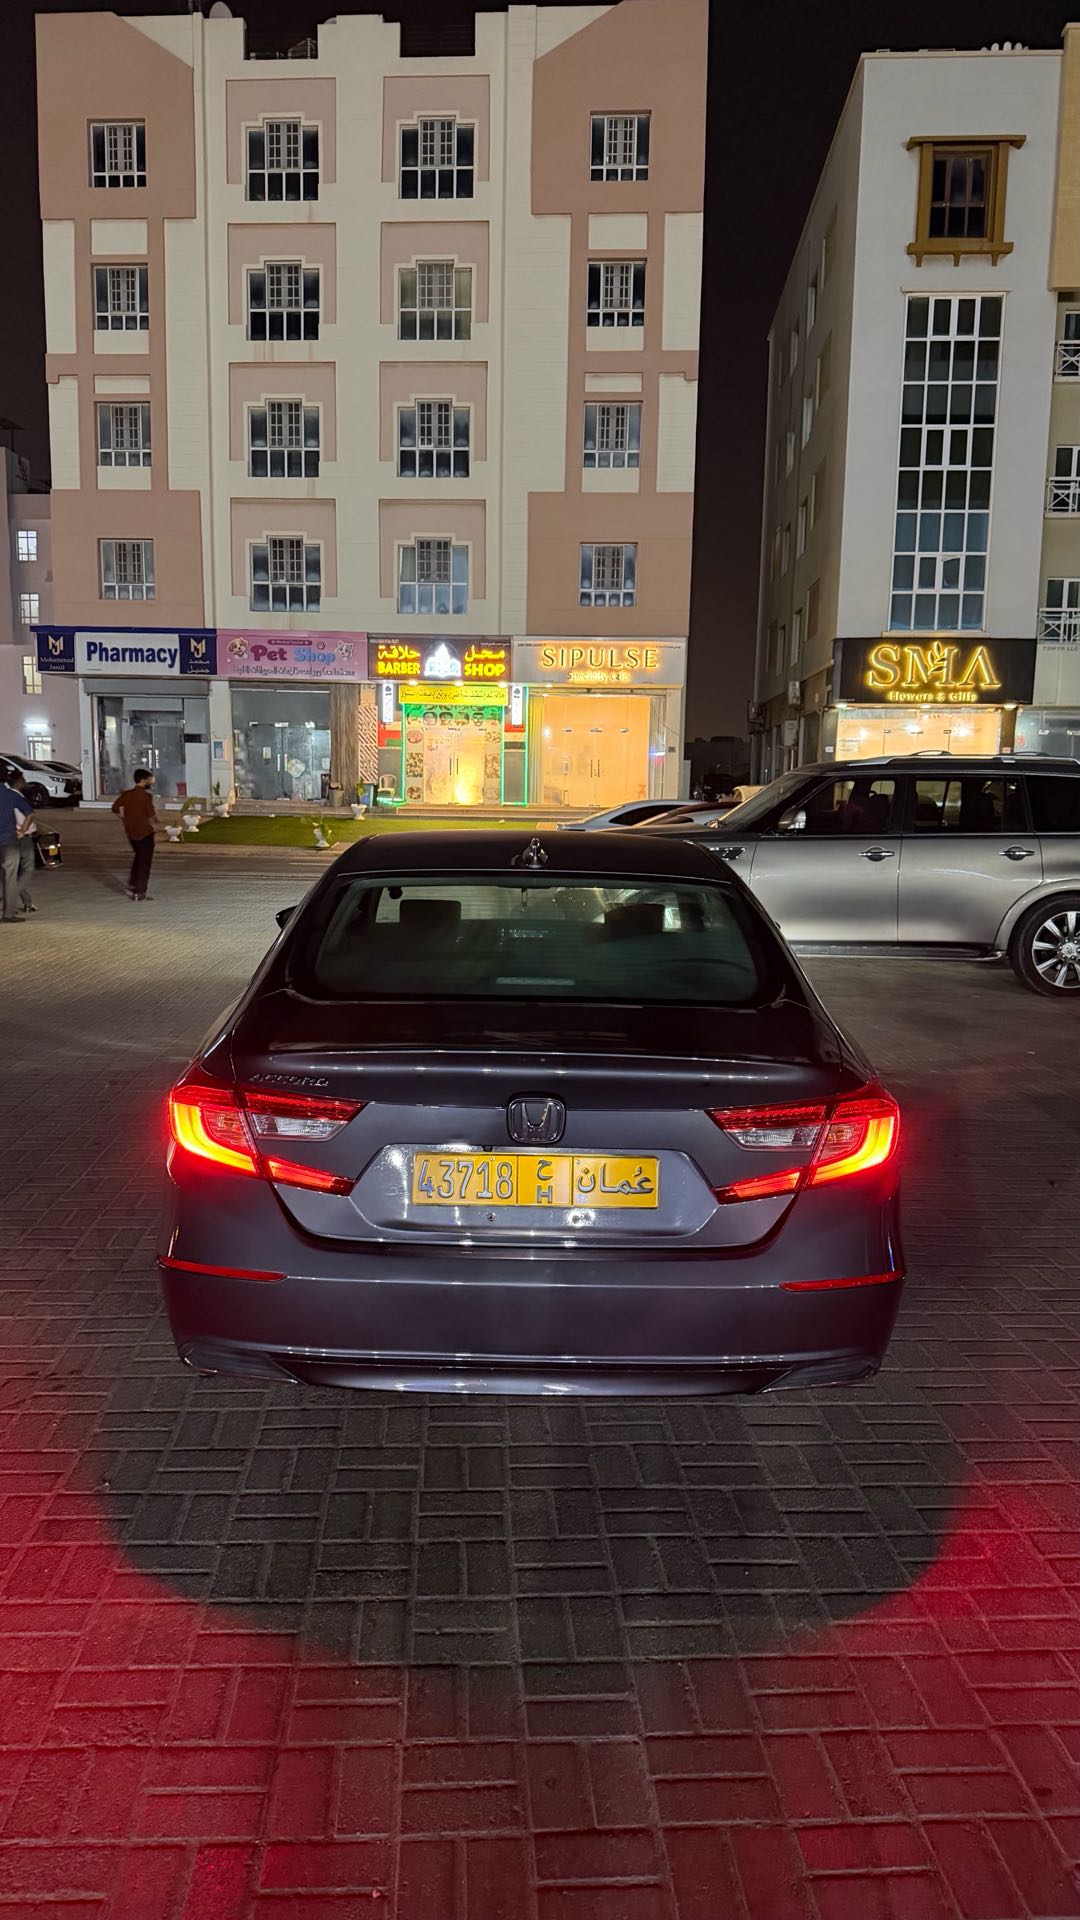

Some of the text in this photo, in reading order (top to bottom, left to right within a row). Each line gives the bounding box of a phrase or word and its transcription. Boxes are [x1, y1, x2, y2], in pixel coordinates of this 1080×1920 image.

[86, 641, 178, 669] Pharmacy
[250, 645, 336, 666] Pet Shop
[377, 645, 506, 662] محل حلاقة
[542, 648, 658, 668] SIPULSE
[187, 665, 210, 674] جميل
[377, 661, 506, 677] BARBER SHOP
[417, 1159, 513, 1199] 43718
[536, 1159, 553, 1181] ح
[536, 1185, 553, 1204] H
